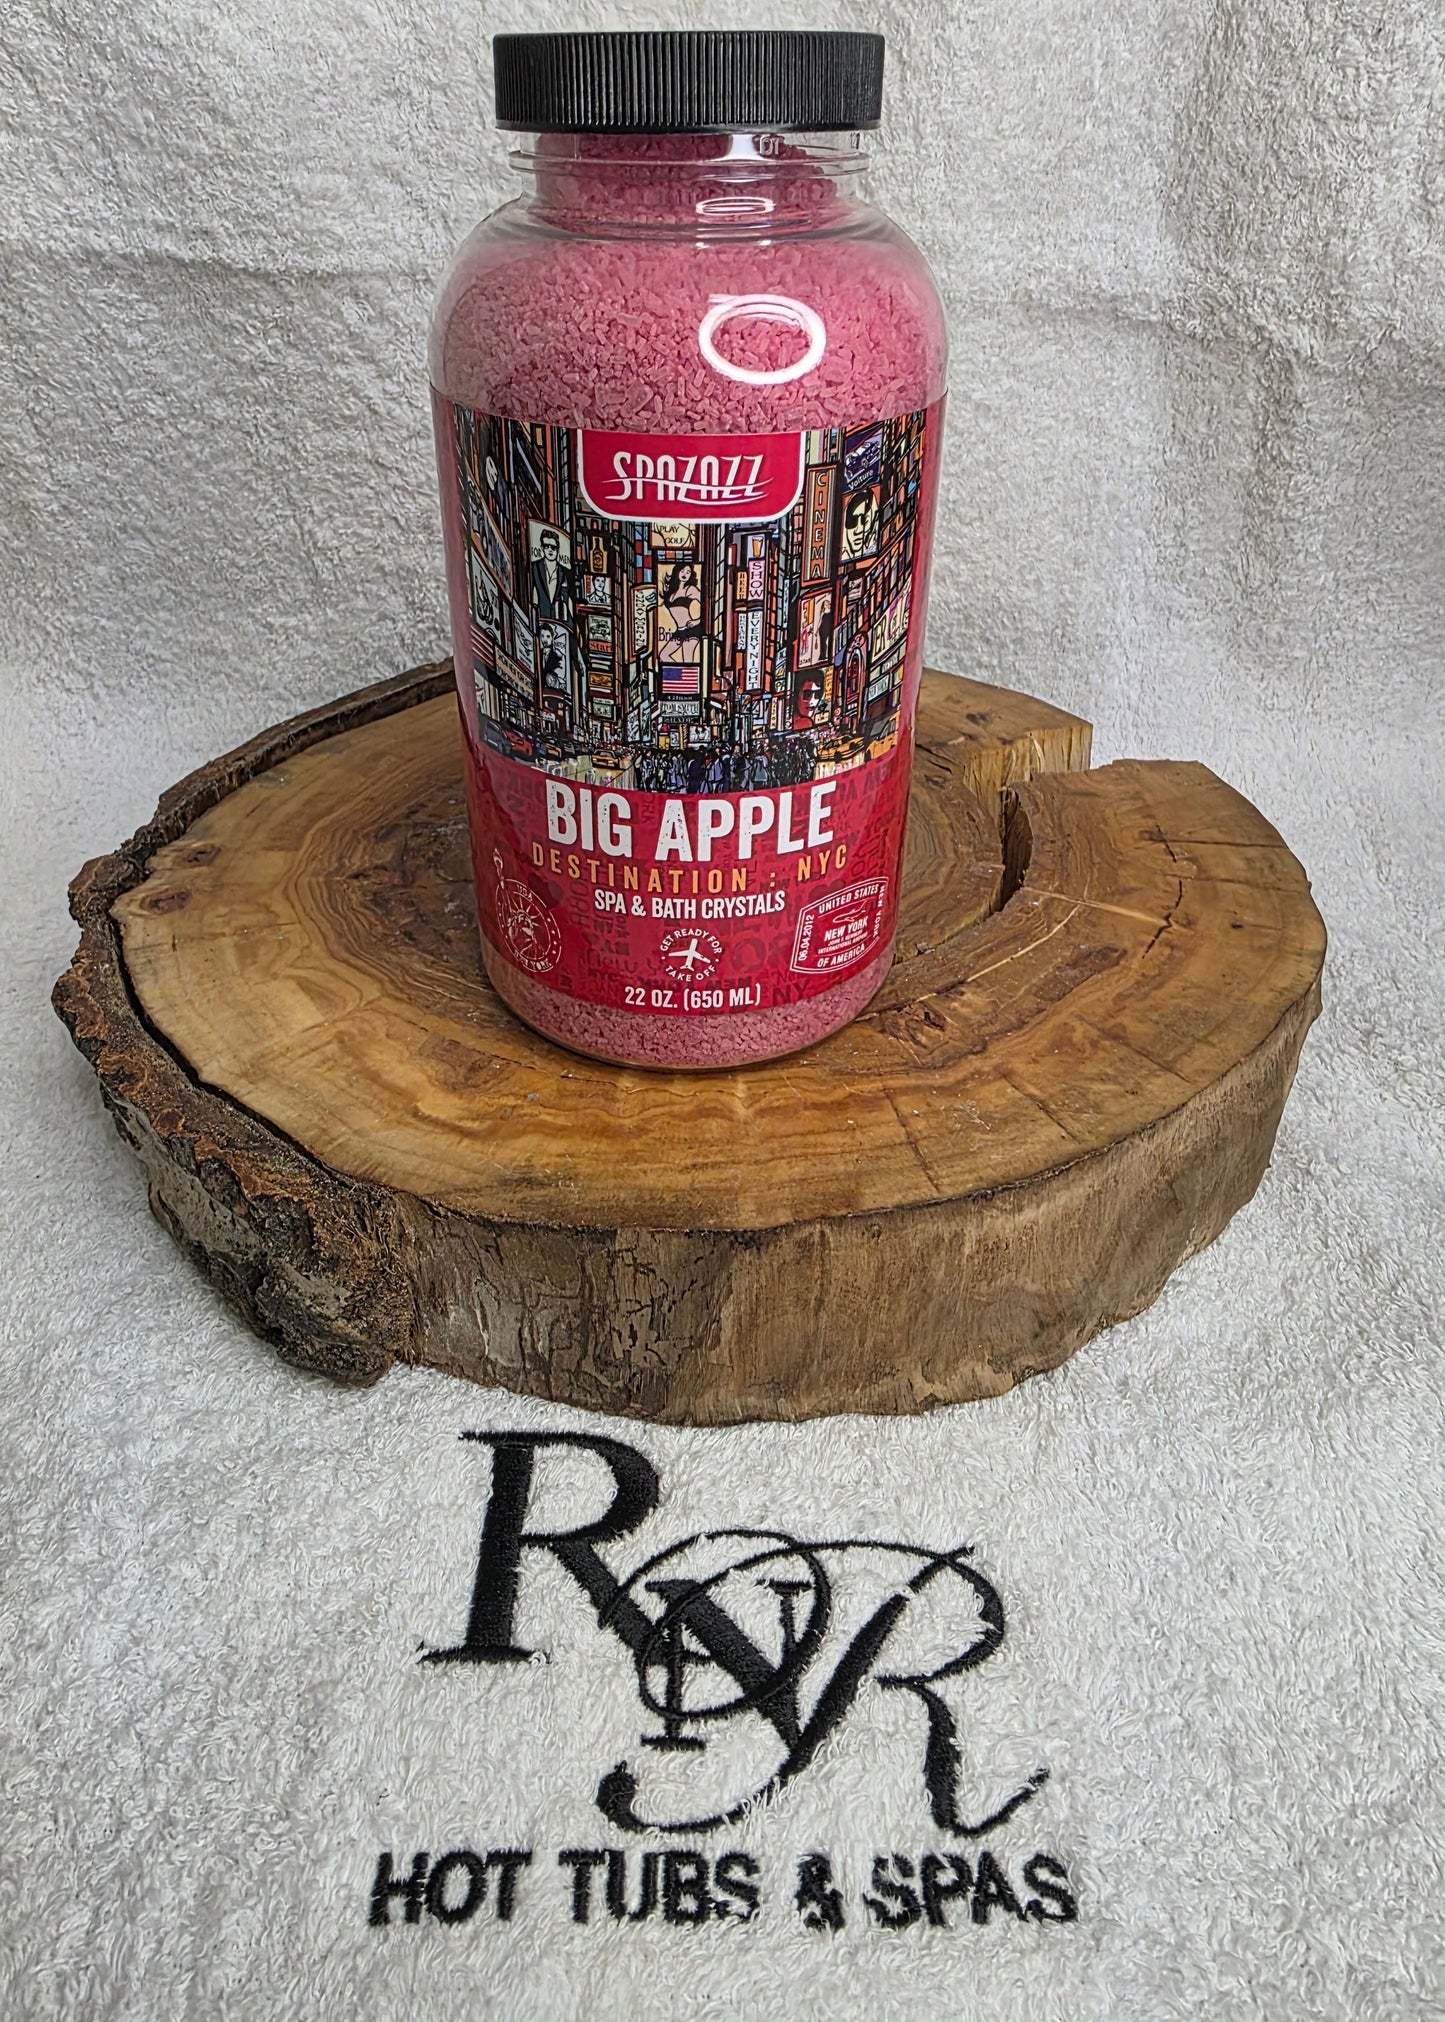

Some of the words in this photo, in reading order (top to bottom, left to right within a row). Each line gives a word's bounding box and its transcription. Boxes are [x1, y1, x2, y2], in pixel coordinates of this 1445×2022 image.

[601, 451, 774, 506] SPAZAZZ
[660, 525, 680, 534] PLAY
[811, 472, 827, 577] CINEMA
[749, 561, 764, 598] SHOW
[749, 612, 760, 650] EVERY
[748, 652, 760, 689] NIGHT
[545, 779, 632, 858] BIG
[655, 780, 837, 862] APPLE
[532, 841, 748, 894] DESTINATION
[797, 844, 847, 882] NYC
[517, 884, 533, 901] USA
[594, 889, 627, 915] SPA
[631, 895, 647, 917] &
[652, 898, 697, 920] BATH
[701, 890, 786, 919] CRYSTALS
[818, 893, 852, 914] UNITED
[854, 884, 880, 900] STATES
[660, 935, 675, 951] GET
[674, 928, 709, 939] READY
[707, 936, 723, 954] FOR
[824, 925, 846, 942] NEW
[847, 916, 869, 934] YORK
[817, 957, 830, 968] OF
[830, 943, 865, 966] AMERICA
[665, 965, 692, 982] TAKE
[696, 964, 716, 980] OFF
[625, 986, 646, 1006] 22
[651, 989, 678, 1008] OZ.
[684, 988, 724, 1011] (650
[729, 982, 761, 1007] ML)
[367, 1851, 533, 1927] HOT
[558, 1848, 761, 1926] TUBS
[797, 1853, 846, 1931] &
[862, 1850, 1080, 1929] SPAS
